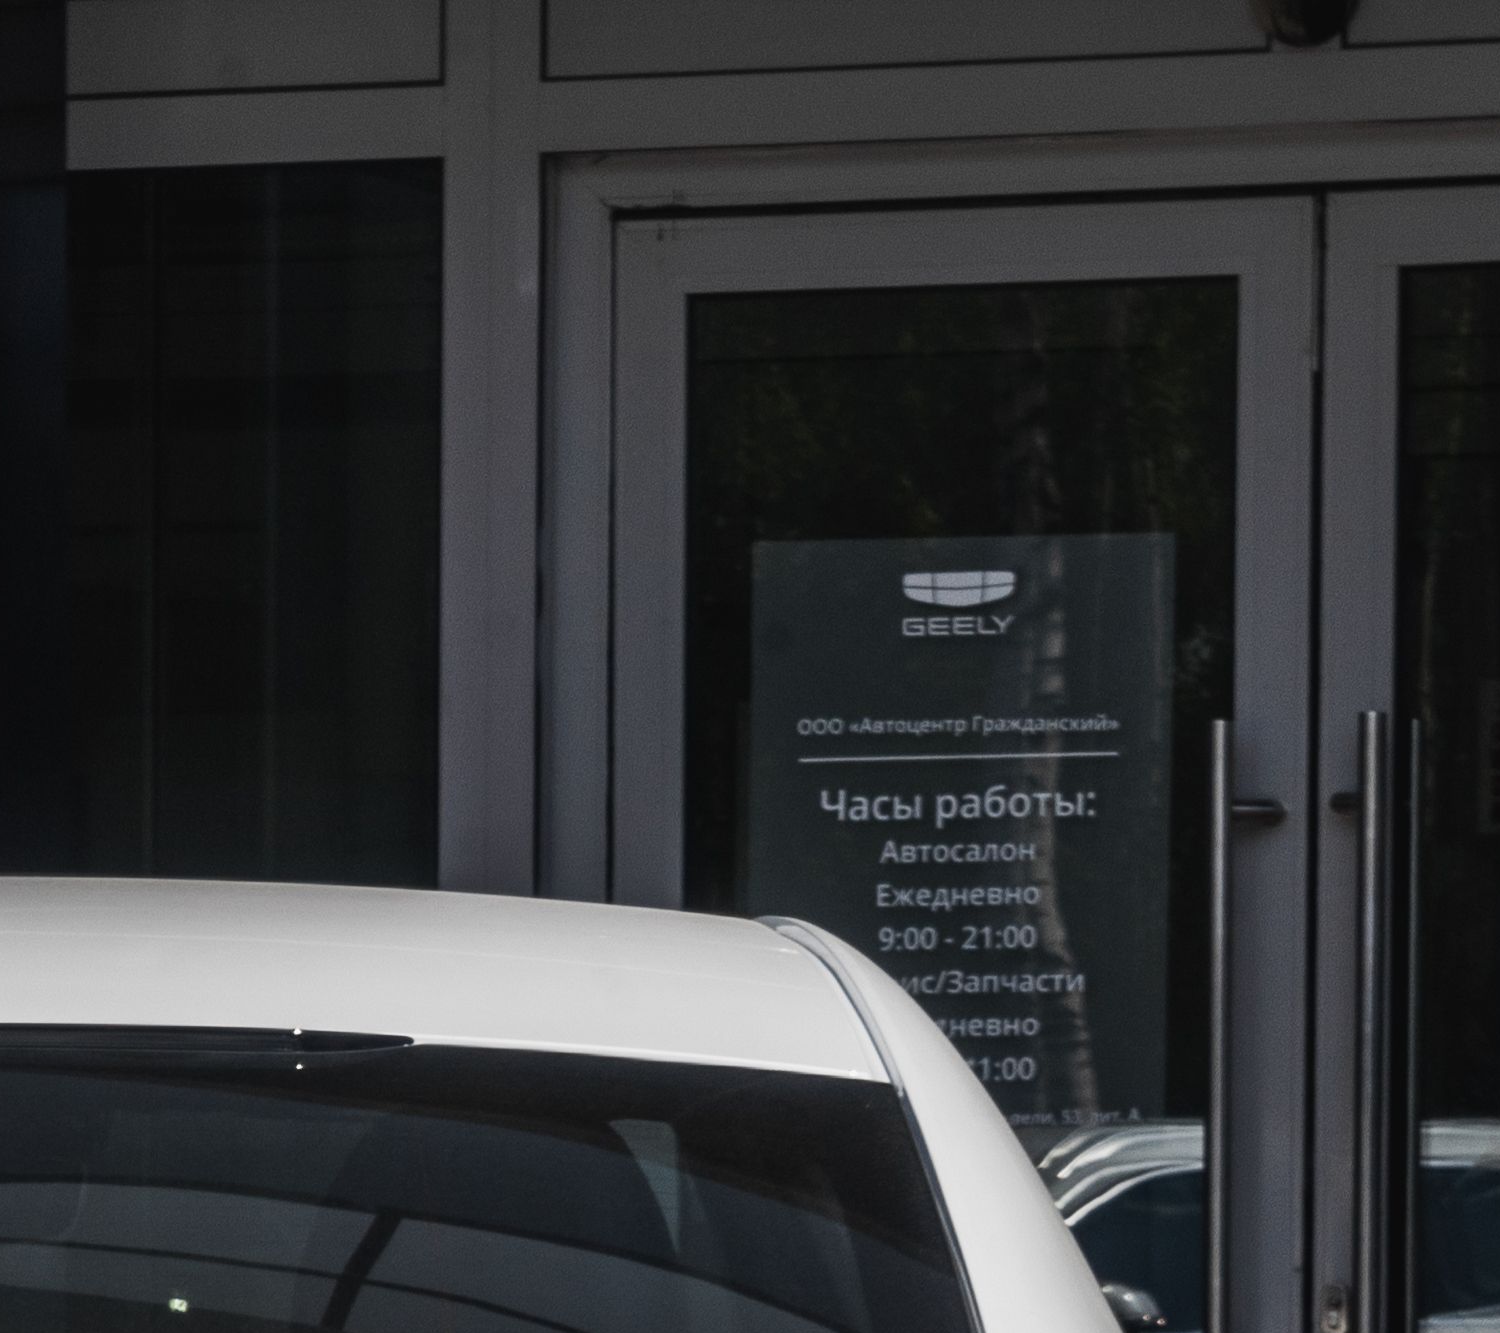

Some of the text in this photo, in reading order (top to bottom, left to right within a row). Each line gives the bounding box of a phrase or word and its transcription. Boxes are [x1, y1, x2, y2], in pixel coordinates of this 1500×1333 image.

[902, 616, 1014, 636] GEELY
[797, 713, 1121, 737] ООО «Автоцентр Гражданский»
[820, 785, 1097, 829] Часы работы:
[879, 840, 1037, 864] Автосалон
[875, 883, 1040, 911] Ежедневно
[878, 927, 938, 950] 9:00
[961, 925, 1038, 949] 21:00
[902, 971, 1085, 994] ис/Запчасти
[940, 1017, 1040, 1037] невно
[969, 1057, 1036, 1081] 1:00
